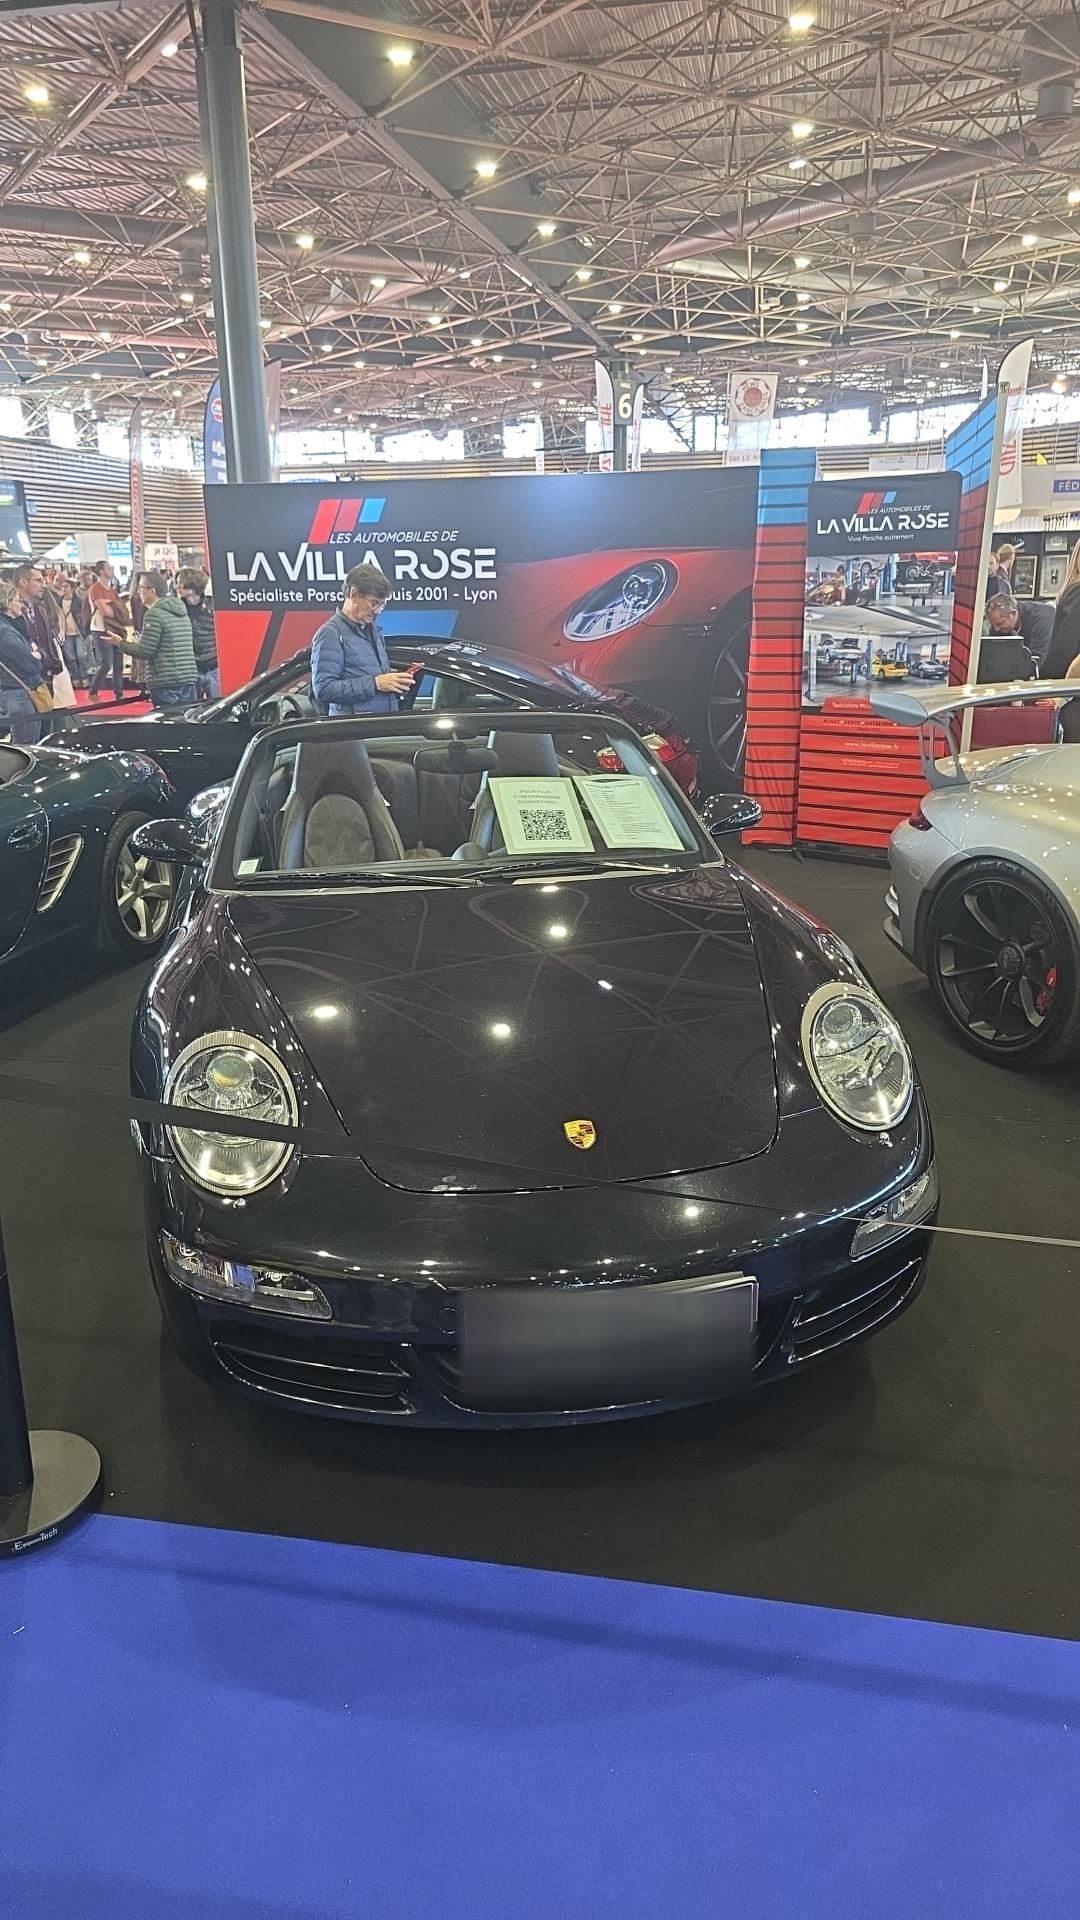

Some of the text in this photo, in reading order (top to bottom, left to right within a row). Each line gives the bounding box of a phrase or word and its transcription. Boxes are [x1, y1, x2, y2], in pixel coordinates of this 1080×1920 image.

[619, 393, 632, 419] 6
[817, 512, 950, 535] LA VILLA ROSE
[330, 531, 458, 544] LES AUTOMOBILES DE
[226, 542, 497, 582] LA VILLA ROSE
[230, 588, 304, 605] Spécialiste
[416, 590, 448, 601] 2001
[464, 588, 498, 604] Lyon
